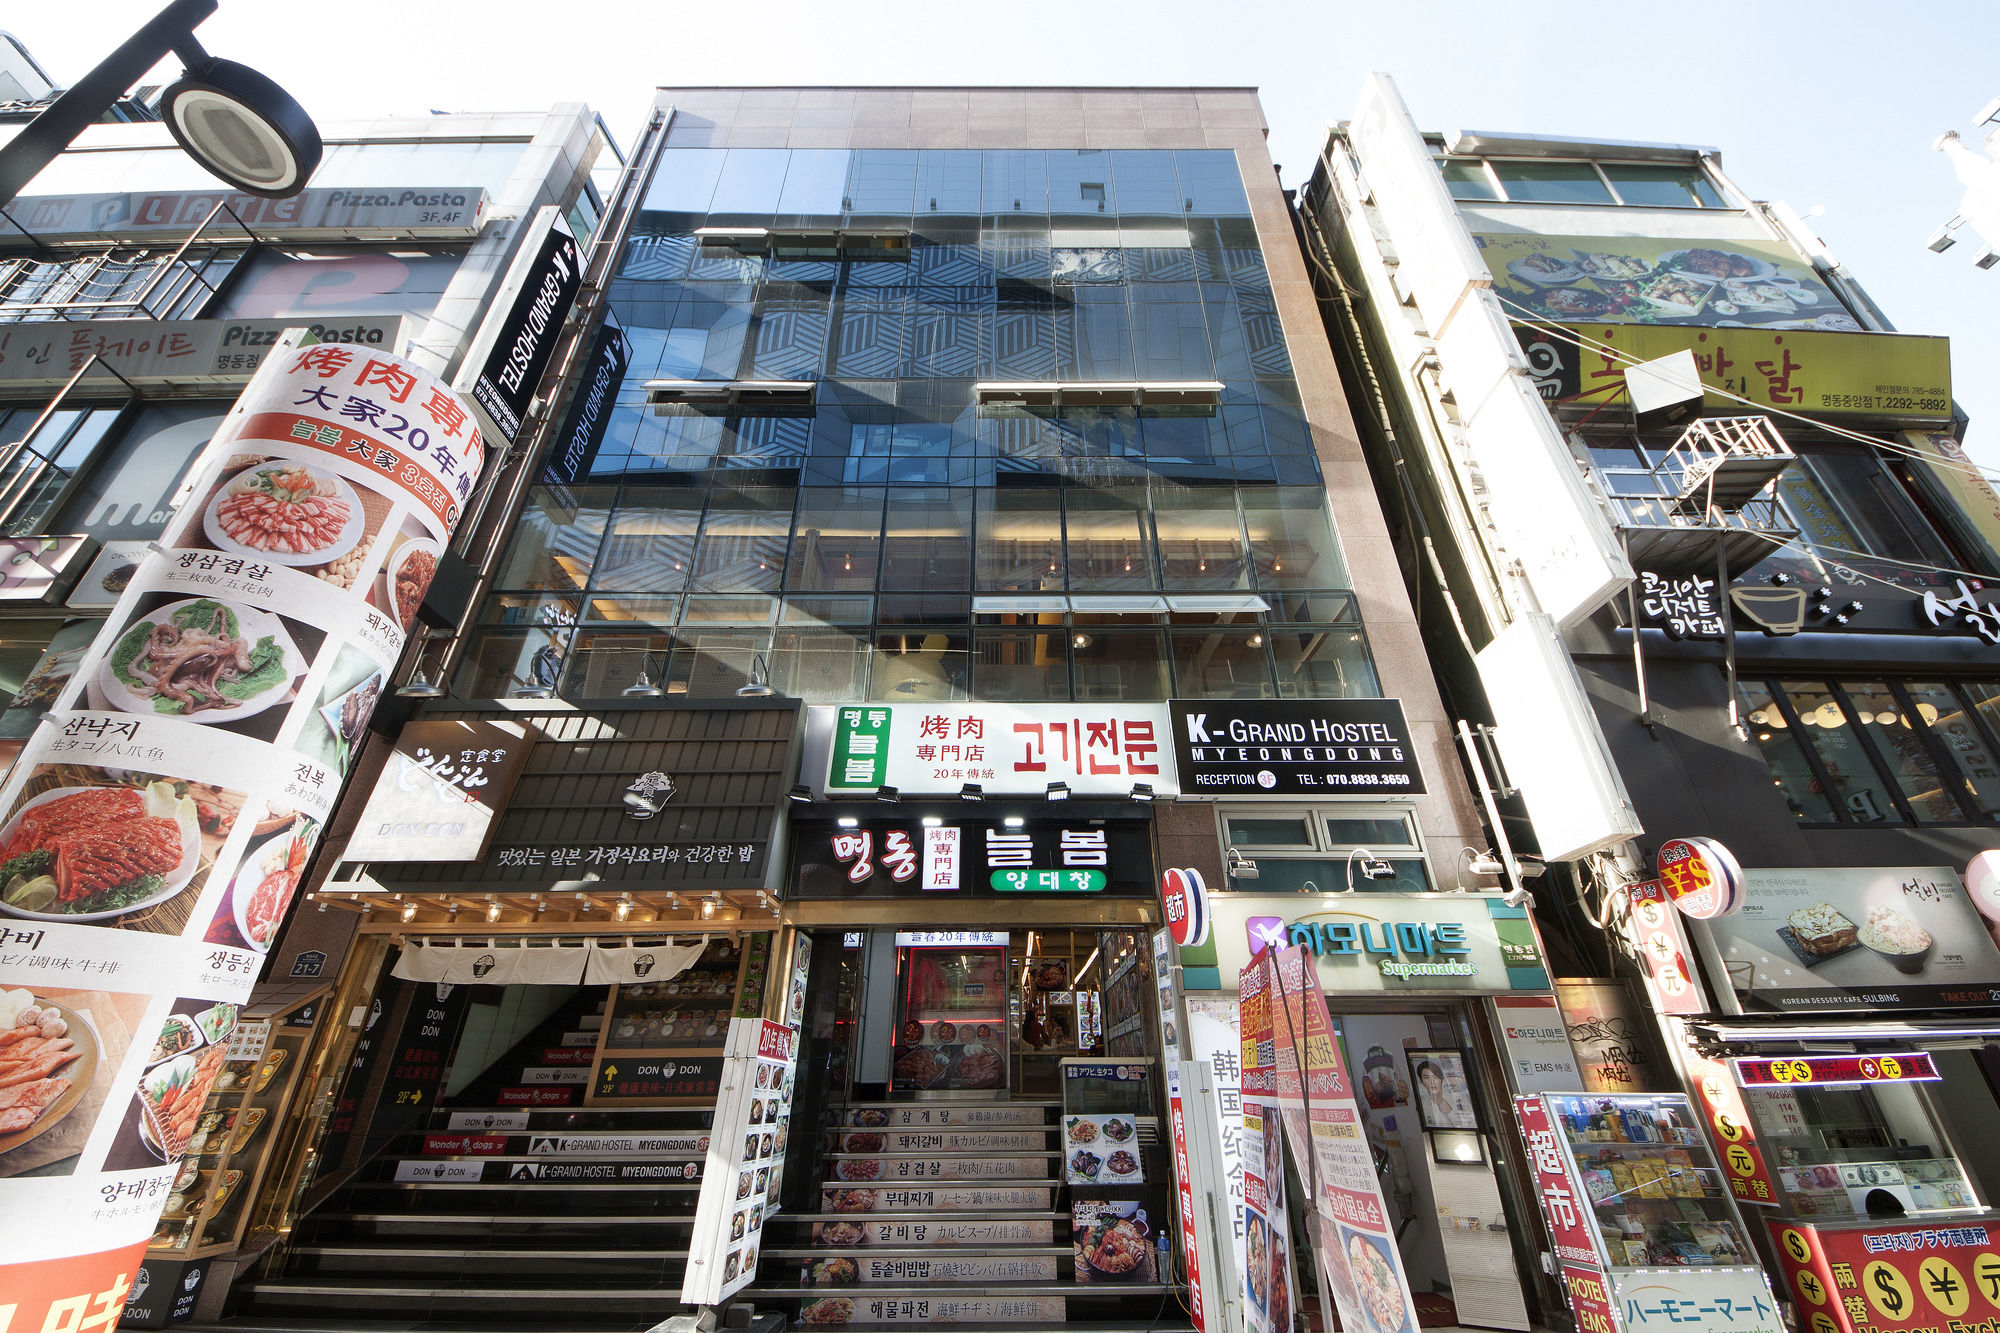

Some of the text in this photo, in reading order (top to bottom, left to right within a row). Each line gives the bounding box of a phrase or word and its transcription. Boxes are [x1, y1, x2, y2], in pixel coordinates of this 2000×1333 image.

[498, 325, 540, 395] HOSTEL
[1875, 385, 1945, 396] 체인점문의 785-4884
[480, 374, 520, 430] MYEONGDONG
[1821, 394, 1946, 411] 명동중앙점 T.2292-5892
[291, 420, 447, 513] 늘봄 大家 3호점
[176, 552, 273, 581] 생삼겹살
[1641, 572, 1714, 599] 코리안
[1644, 598, 1717, 616] 디저트
[844, 710, 886, 728] 명동
[920, 715, 984, 740] 烤肉
[62, 717, 141, 741] 산낙지
[1311, 719, 1398, 742] HOSTEL
[1013, 717, 1159, 776] 고기전문
[1191, 748, 1404, 761] MYEONGDONG
[460, 749, 506, 763] 定食堂
[845, 731, 878, 782] 늘봄
[294, 763, 325, 789] 전복
[1196, 774, 1255, 785] RECEPTION
[1260, 775, 1274, 785] 3F
[1327, 774, 1410, 785] 070.8838.3650
[638, 773, 661, 809] 定食堂
[929, 830, 956, 841] 烤肉
[498, 845, 755, 867] 맛있는 일본 가정식요리와 건강한 밥
[832, 829, 918, 883] 명동
[1006, 871, 1092, 890] 양대창
[1902, 878, 1941, 902] 설빙
[1165, 890, 1185, 923] 超市
[1289, 921, 1473, 957] 하모니마트
[206, 951, 255, 974] 생등심
[295, 963, 320, 974] 21-7
[1381, 957, 1477, 981] Supermarket
[1781, 997, 1811, 1005] KOREAN
[1812, 996, 1842, 1004] DESSERT
[1862, 994, 1900, 1003] SULBING
[1940, 991, 1966, 1002] TAKE
[1968, 990, 1989, 1001] OUT
[427, 1009, 445, 1021] DON
[421, 1026, 440, 1037] DON
[1518, 1027, 1565, 1039] 하모니마트
[548, 1052, 572, 1060] Wonder
[637, 1066, 702, 1075] DON DON
[1535, 1064, 1553, 1073] EMS
[396, 1091, 411, 1105] 2F
[504, 1092, 560, 1101] Wonder dogs
[602, 1085, 614, 1094] 2F
[464, 1119, 512, 1127] DON DON
[901, 1111, 950, 1124] 삼계탕
[429, 1140, 493, 1150] Wonder dogs
[602, 1140, 634, 1151] HOSTEL
[639, 1140, 696, 1150] MYEONGDONG
[899, 1135, 943, 1149] 돼지갈비
[897, 1162, 942, 1176] 삼겹살
[1731, 1150, 1751, 1171] 元
[413, 1168, 466, 1176] DON DON
[583, 1166, 617, 1177] HOSTEL
[622, 1166, 682, 1177] MYEONGDONG
[685, 1167, 697, 1177] 3F
[1528, 1129, 1577, 1233] 超市
[884, 1191, 934, 1207] 부대찌개
[879, 1224, 928, 1241] 갈비탕
[870, 1260, 931, 1278] 돌솥비빔밥
[1567, 1275, 1606, 1304] HOTEL
[178, 1295, 194, 1306] DON
[173, 1307, 190, 1318] DON
[870, 1300, 929, 1319] 해물파전
[1627, 1295, 1771, 1324] ハーモニーマート
[1580, 1309, 1610, 1333] EMS
